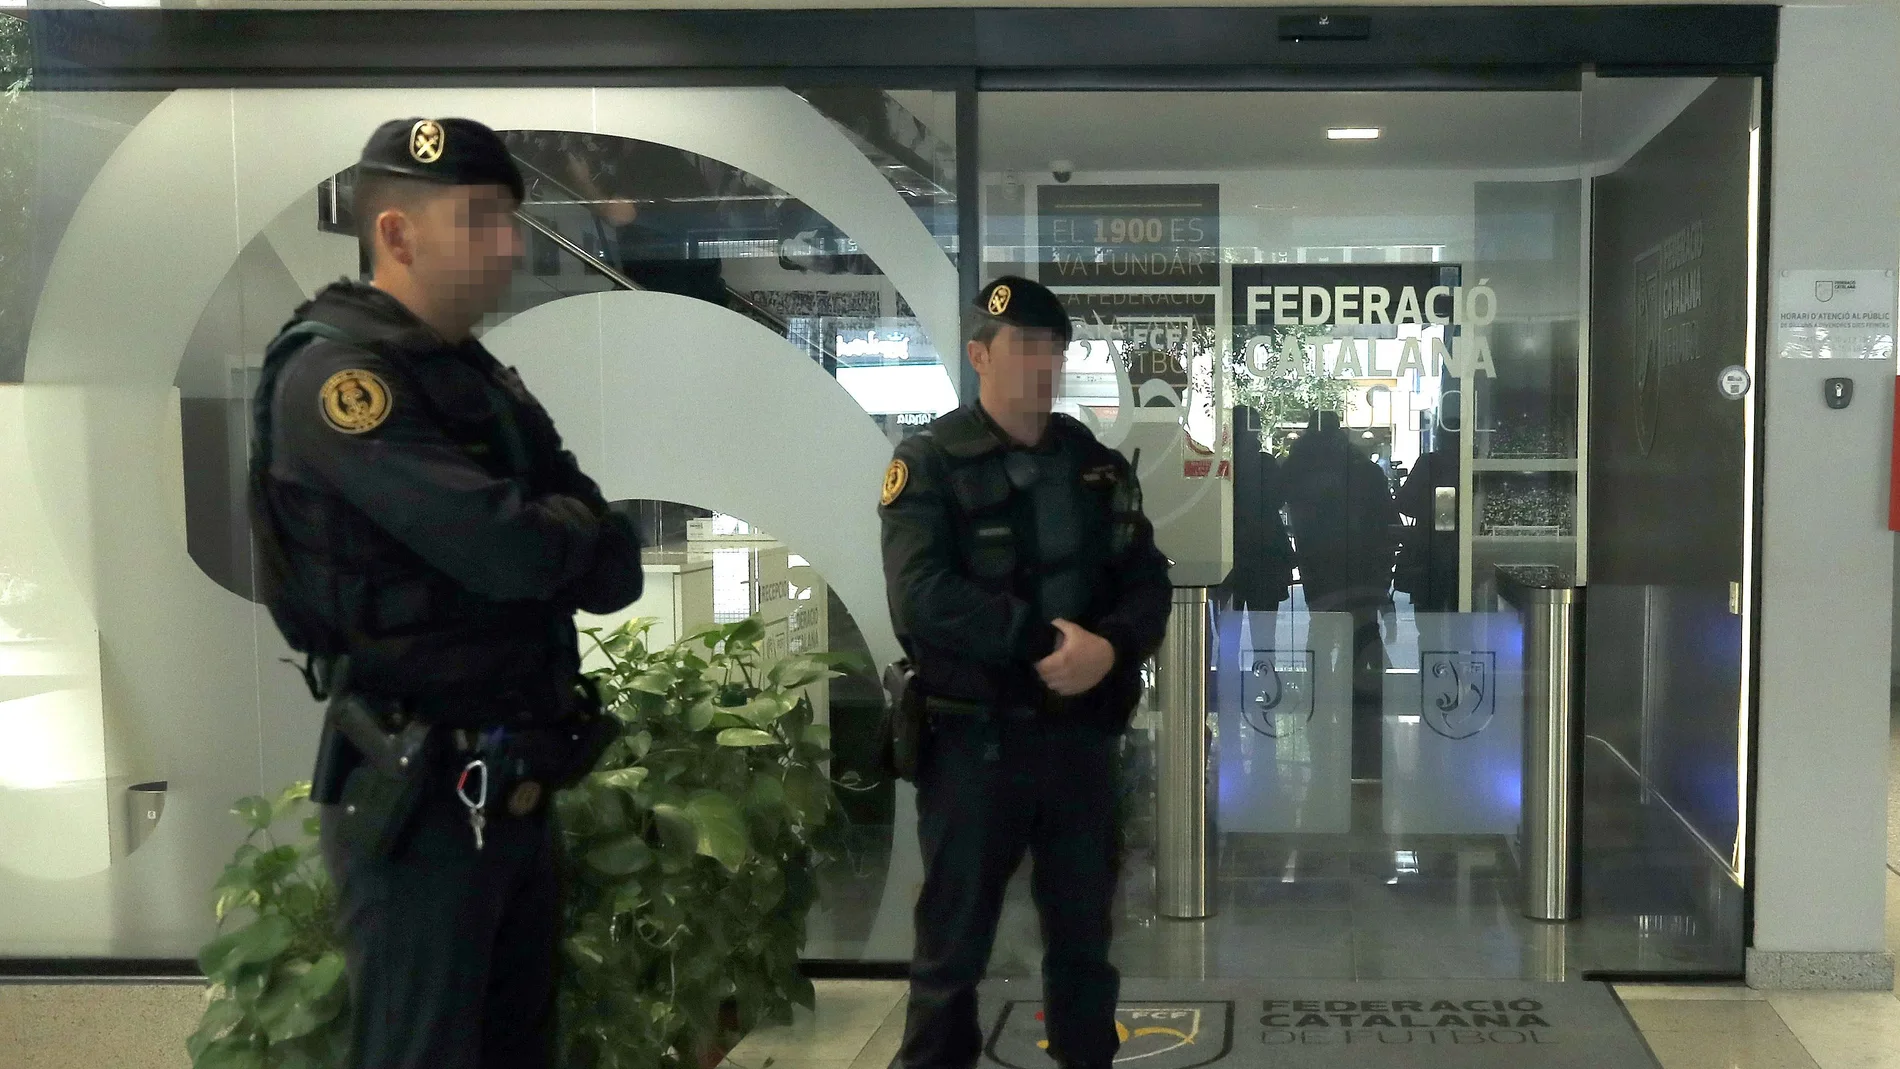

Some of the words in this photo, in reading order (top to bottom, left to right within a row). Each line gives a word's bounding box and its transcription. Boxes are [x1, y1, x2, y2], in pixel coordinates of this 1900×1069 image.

[1052, 218, 1084, 244] EL
[1093, 217, 1163, 244] 1900
[1170, 217, 1205, 243] ES
[1053, 252, 1088, 276] VA
[1247, 278, 1498, 326] FEDERACIÓ
[1780, 312, 1809, 320] HORARI
[1811, 311, 1850, 320] D'ATENCIÓ
[1852, 312, 1861, 320] AL
[1863, 311, 1890, 320] PÚBLIC
[1133, 327, 1183, 350] FCF
[1245, 335, 1498, 379] CATALANA
[1262, 996, 1543, 1013] FEDERACIÓ
[1131, 1011, 1188, 1020] FCF
[1259, 1013, 1554, 1028] CATALANA
[1261, 1029, 1330, 1045] DE
[1344, 1029, 1562, 1045] FUTBOL
